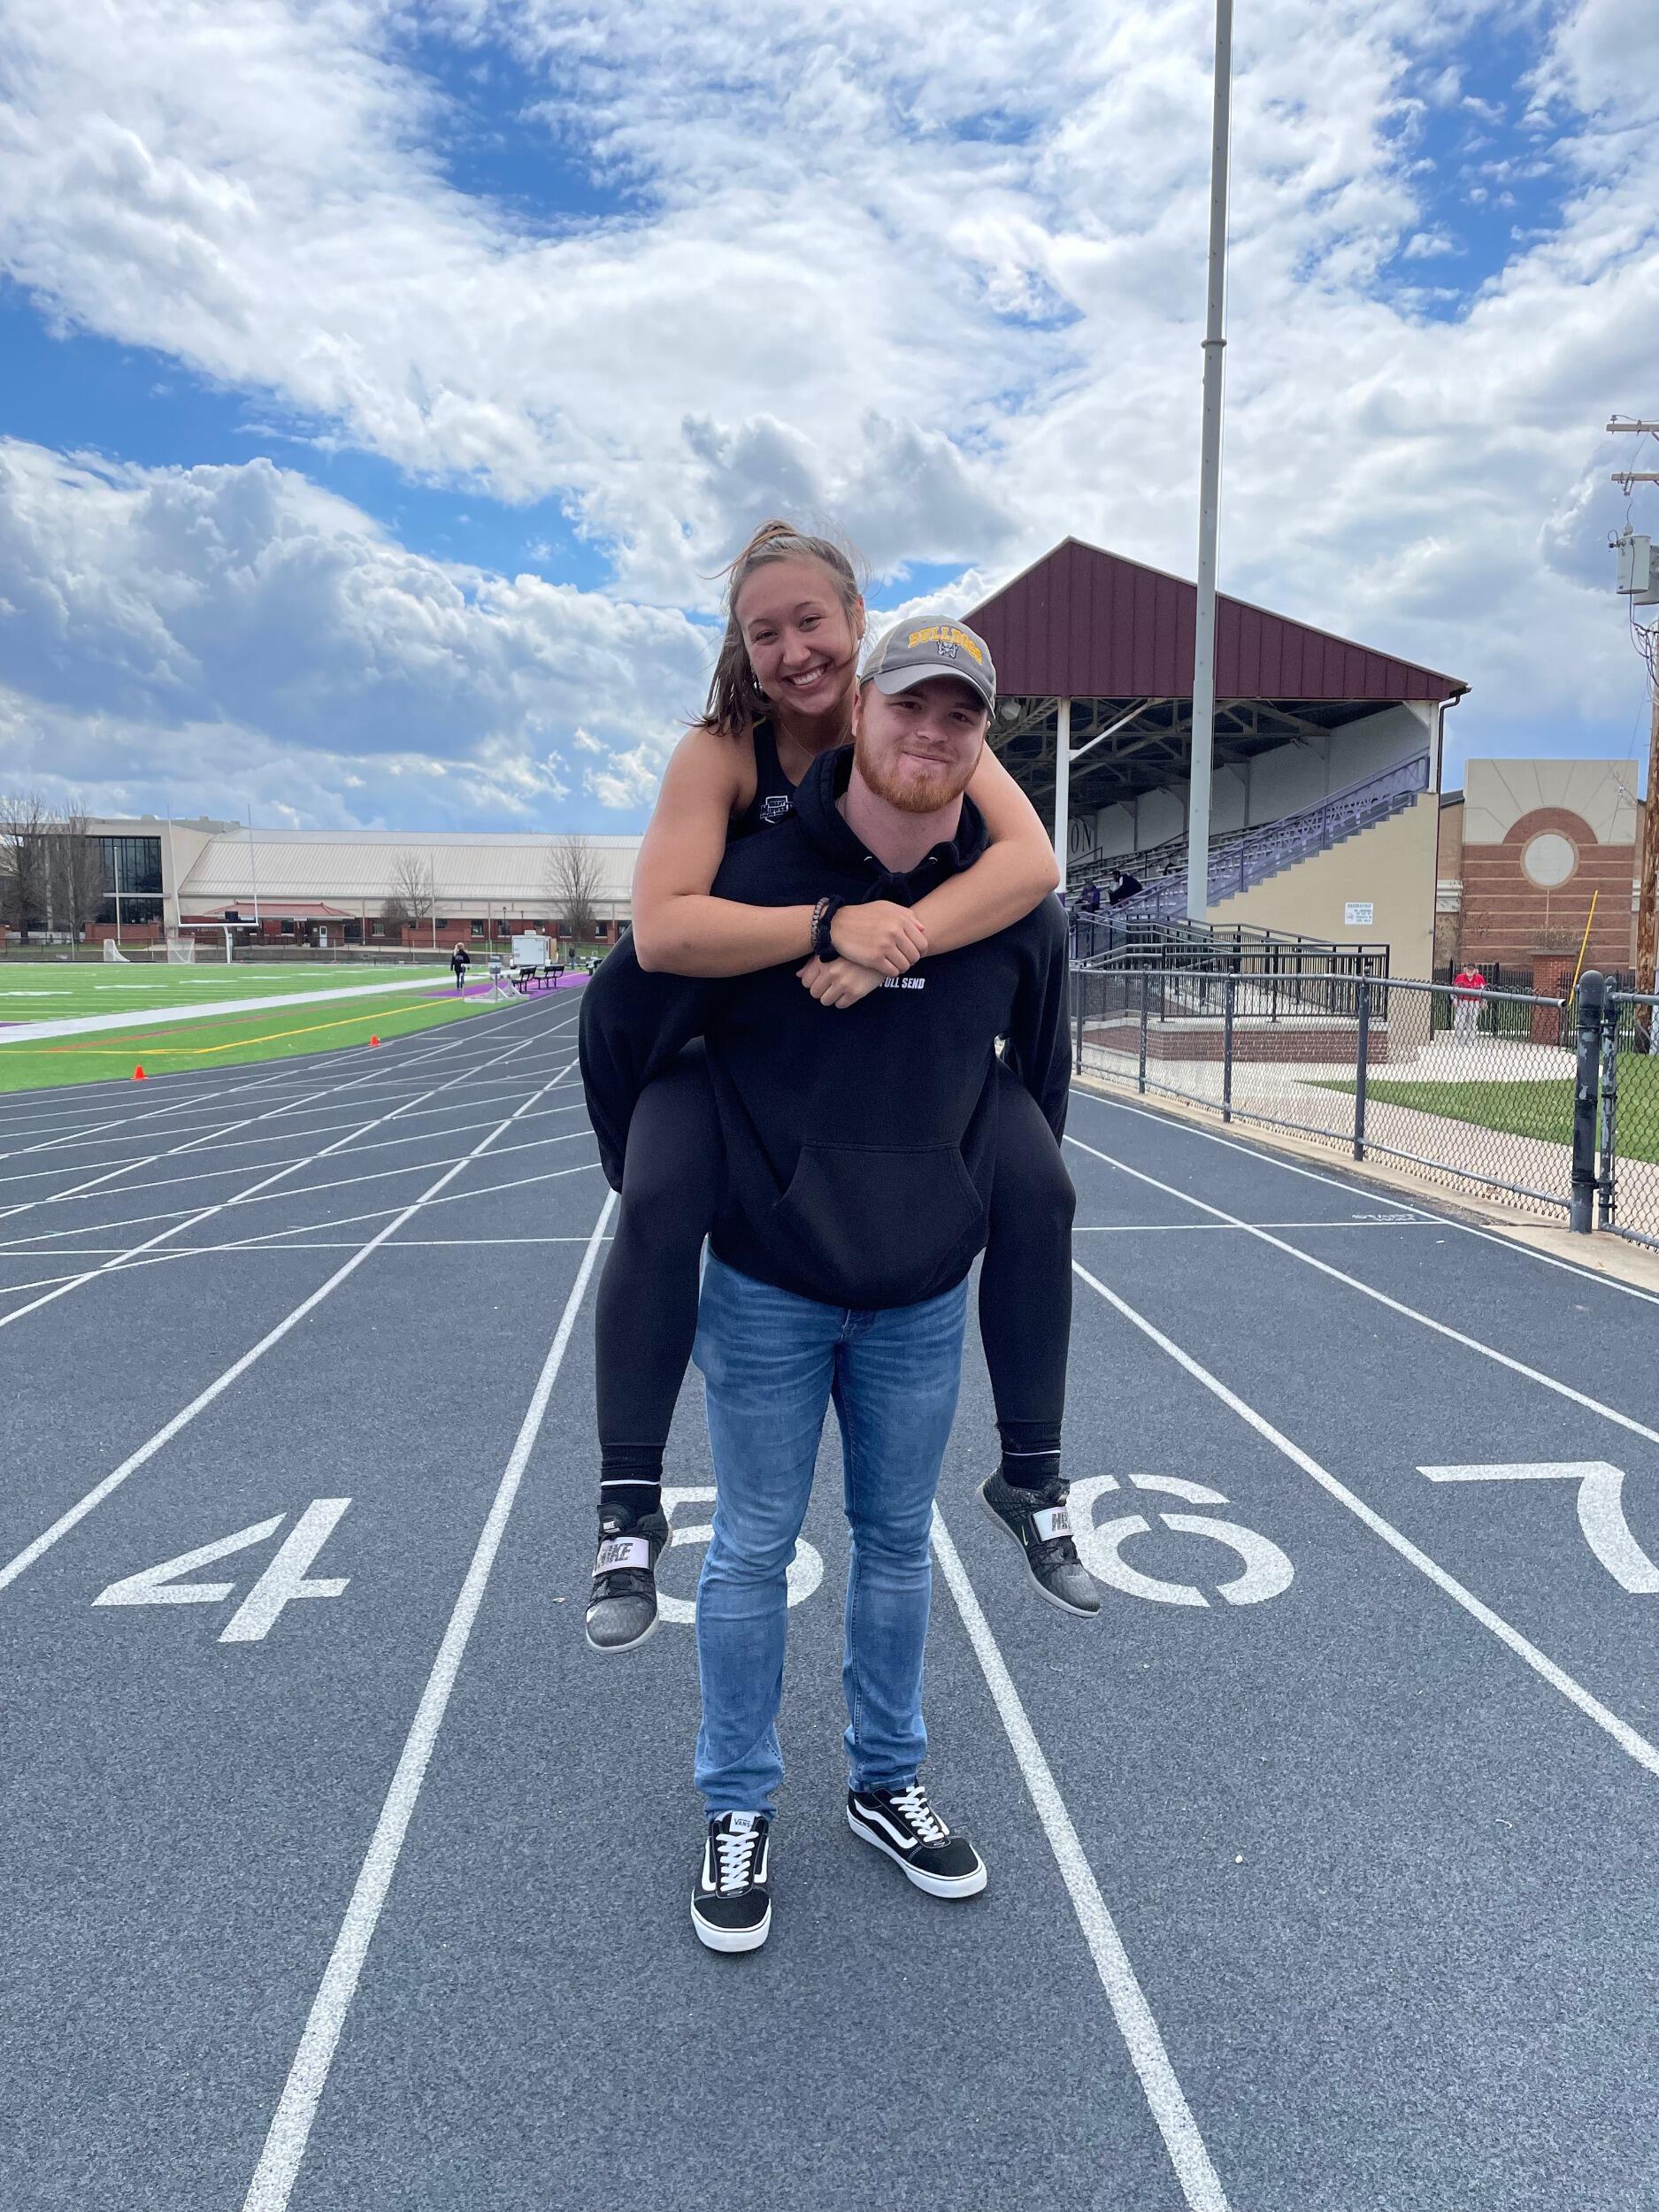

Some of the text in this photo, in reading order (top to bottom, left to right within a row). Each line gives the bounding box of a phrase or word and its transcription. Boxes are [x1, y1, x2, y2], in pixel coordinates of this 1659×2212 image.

[902, 977, 926, 989] SEND
[90, 1497, 353, 1644] 4
[1066, 1473, 1295, 1607] 6
[1416, 1461, 1659, 1594] 7
[733, 1818, 751, 1828] VANS
